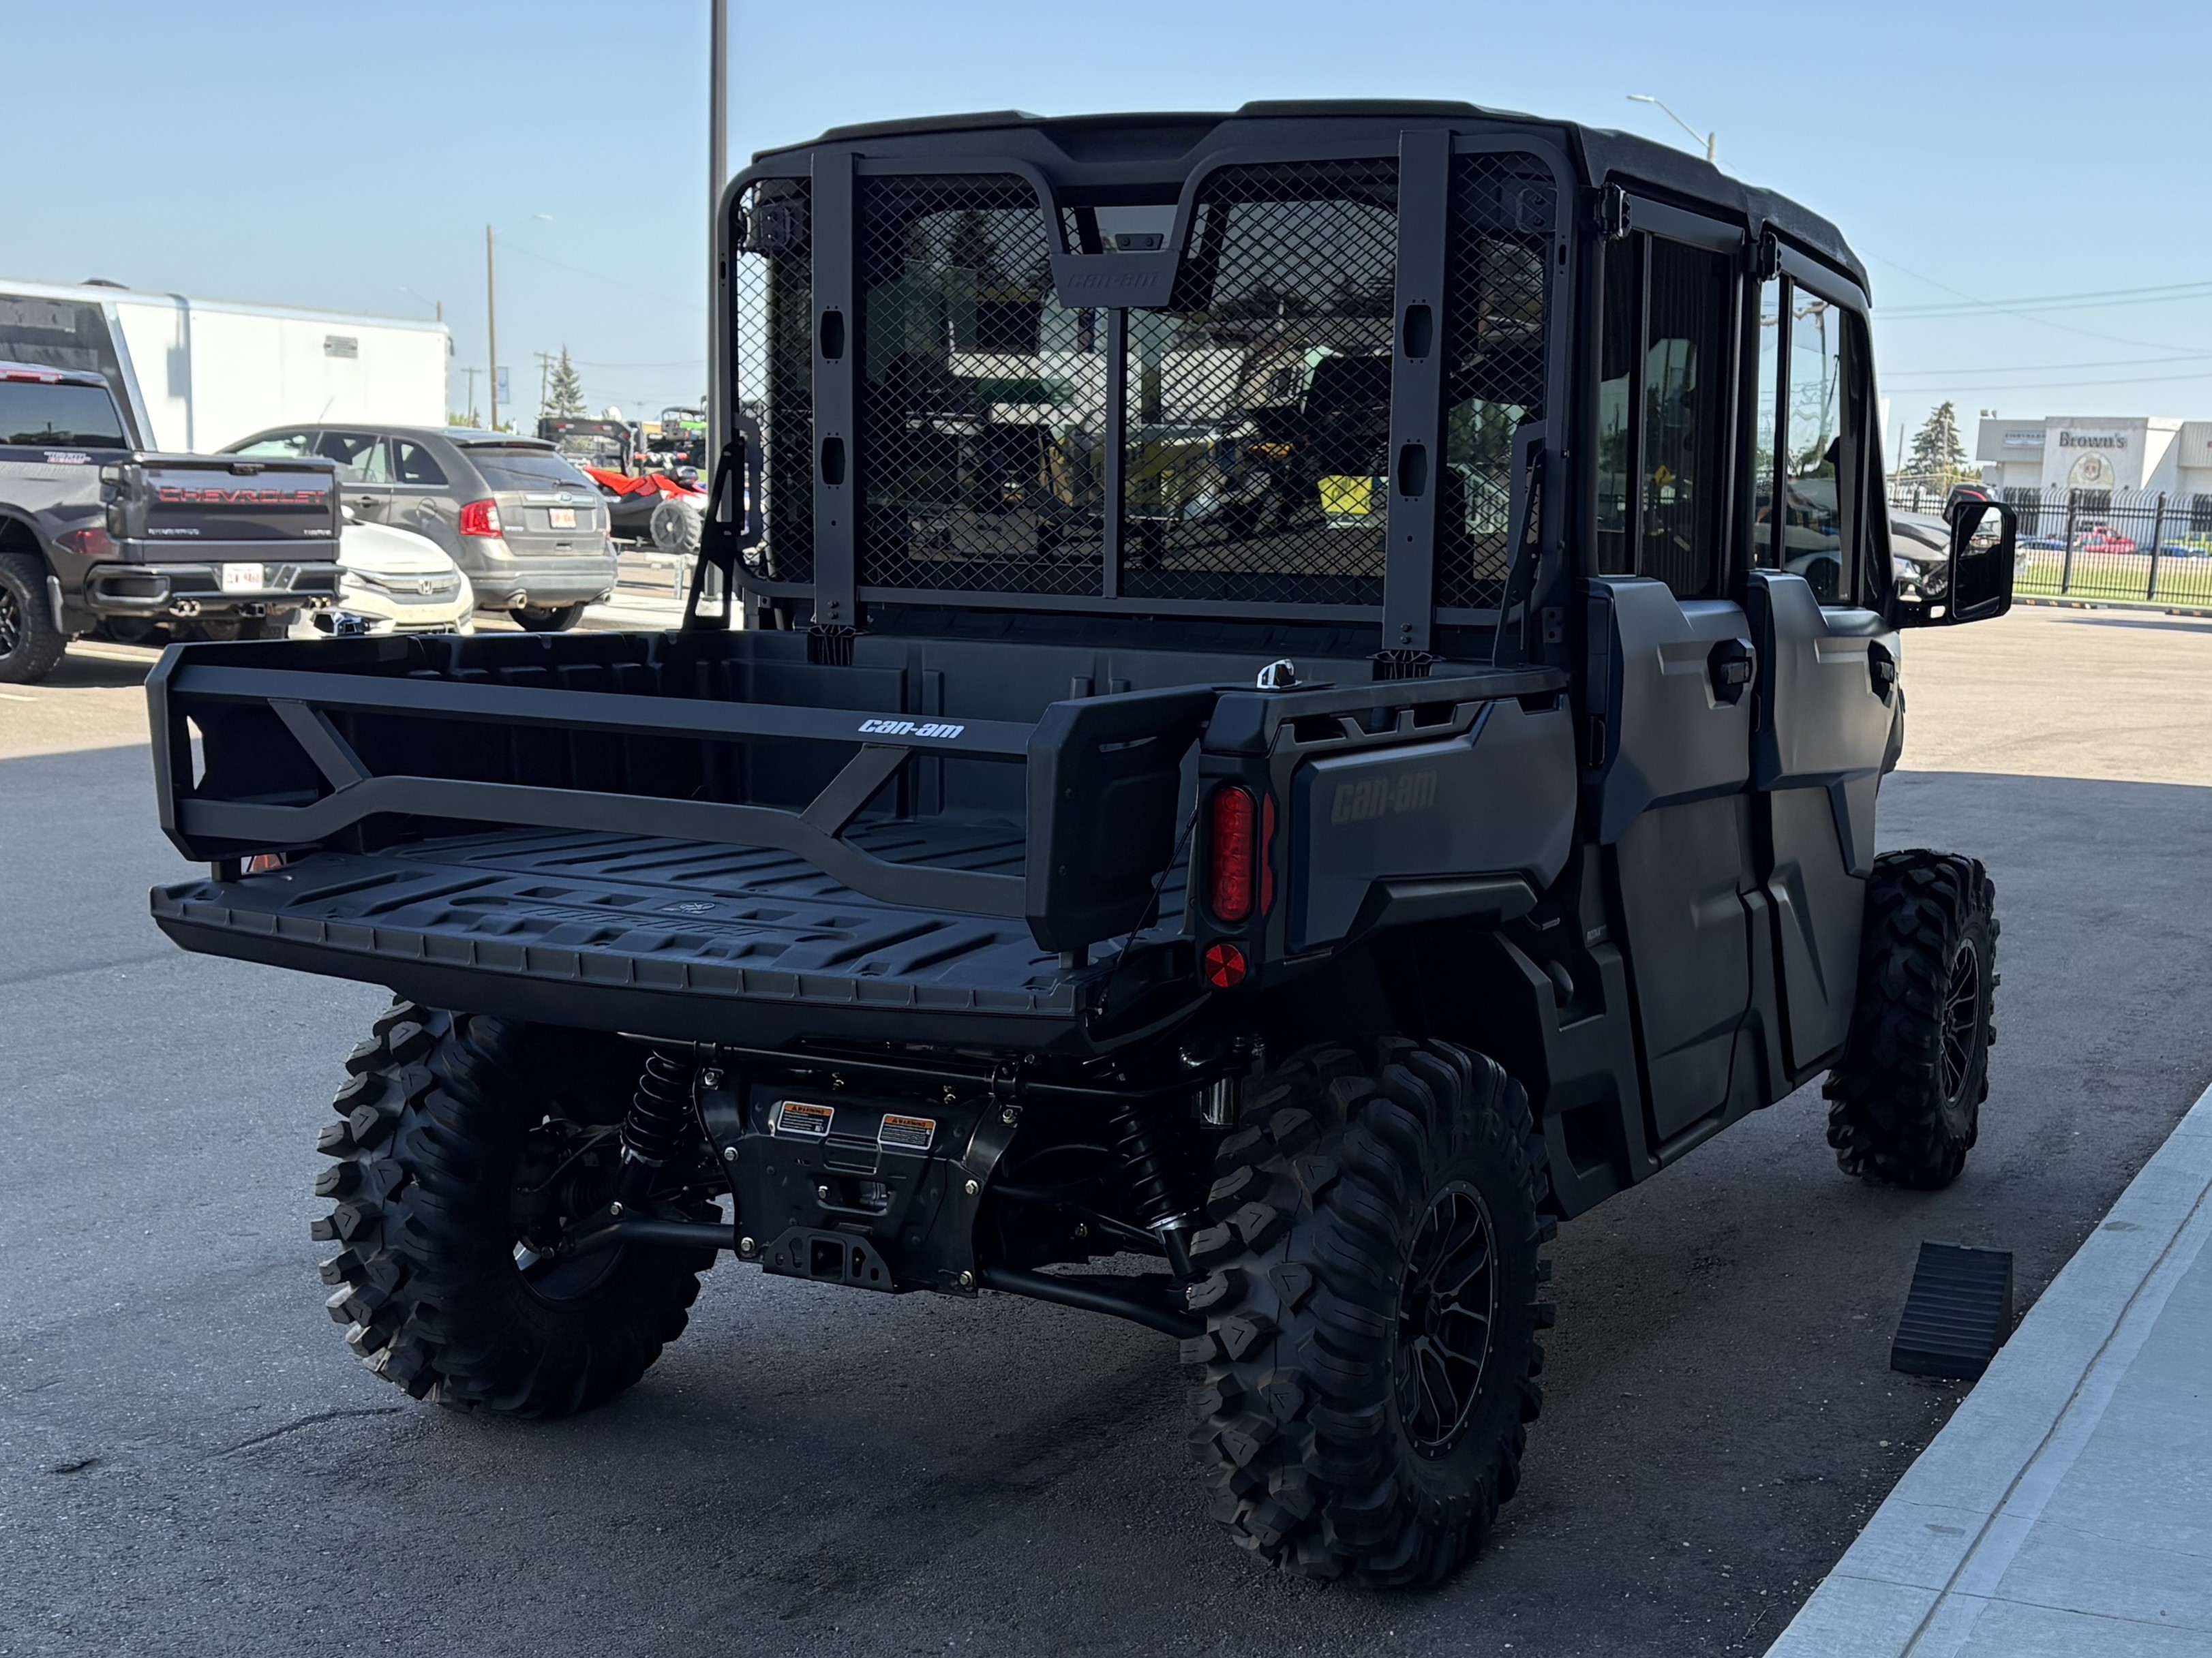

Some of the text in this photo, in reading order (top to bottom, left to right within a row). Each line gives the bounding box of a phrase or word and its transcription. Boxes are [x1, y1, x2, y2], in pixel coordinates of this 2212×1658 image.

[1067, 273, 1159, 288] can-am
[2059, 431, 2126, 448] Brown's
[159, 487, 326, 503] CHEVROLET
[858, 719, 965, 739] can-am
[1331, 769, 1438, 826] can-am
